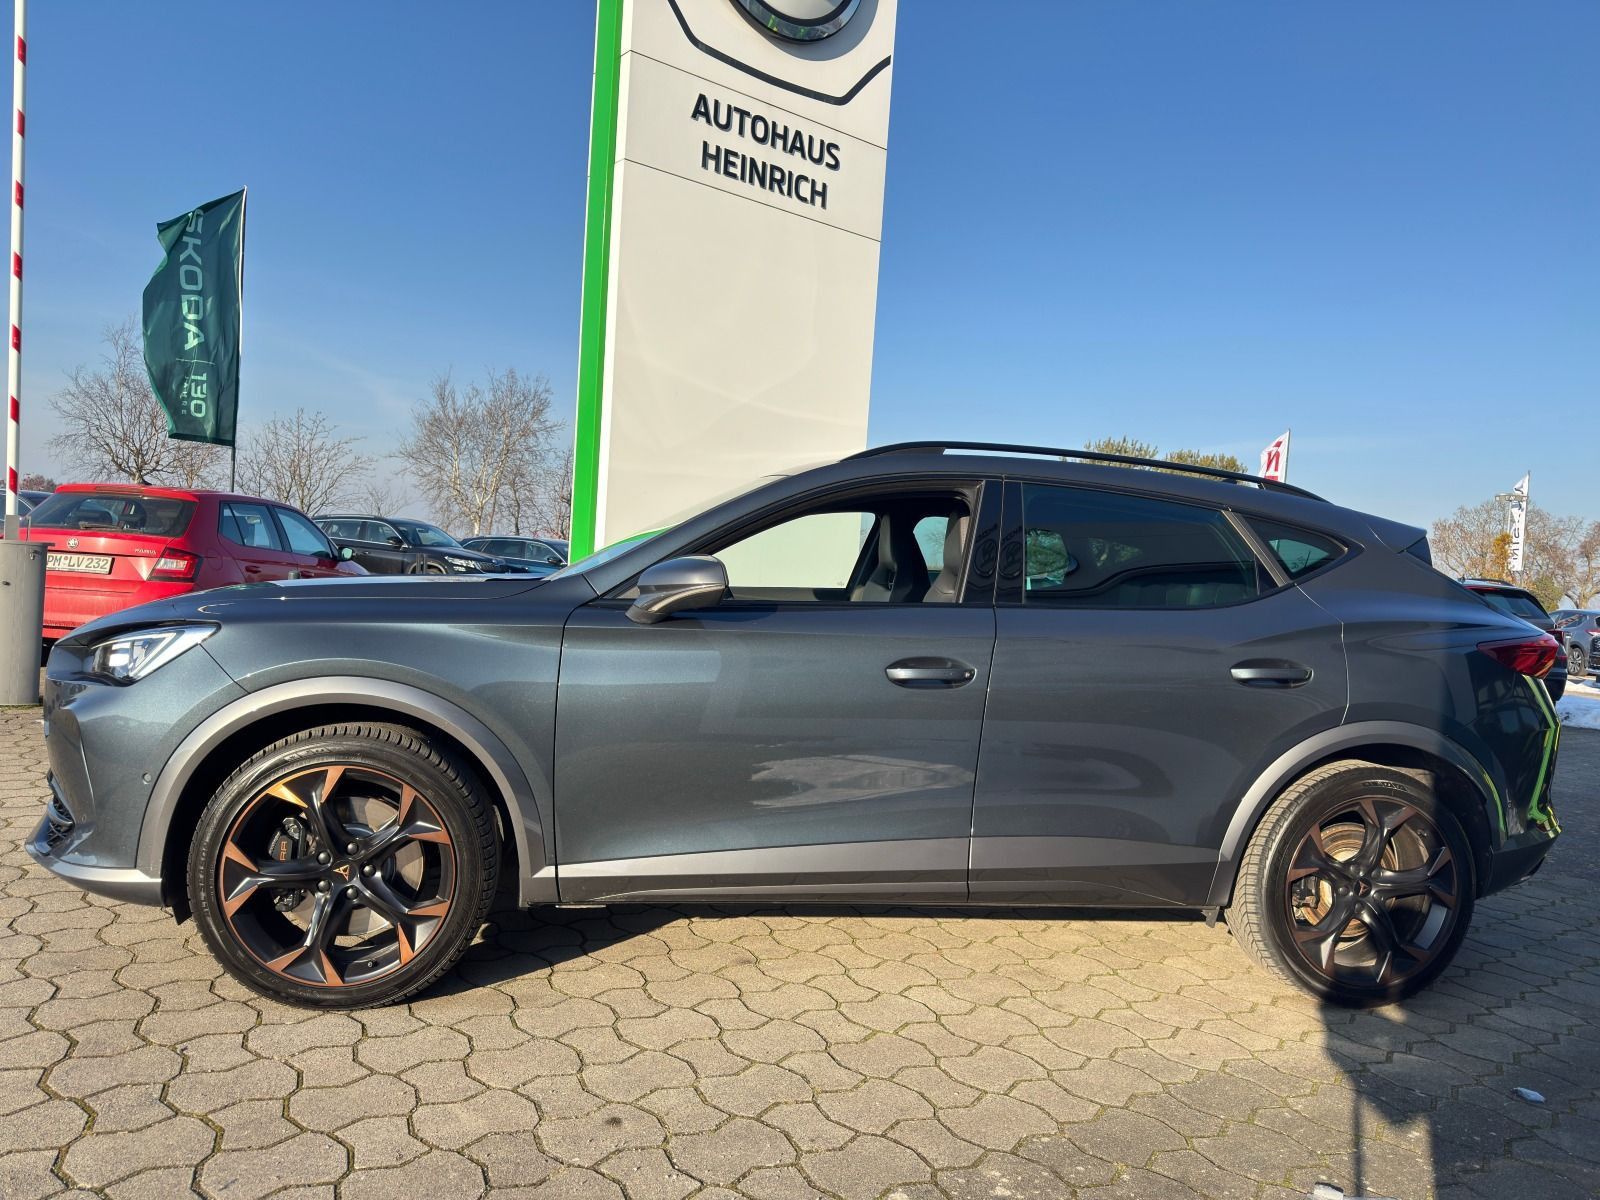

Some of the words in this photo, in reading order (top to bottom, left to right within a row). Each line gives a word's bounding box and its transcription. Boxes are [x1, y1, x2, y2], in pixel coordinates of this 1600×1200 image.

[691, 93, 840, 171] AUTOHAUS
[701, 140, 827, 210] HEINRICH
[190, 372, 207, 417] 130
[85, 557, 109, 570] 232
